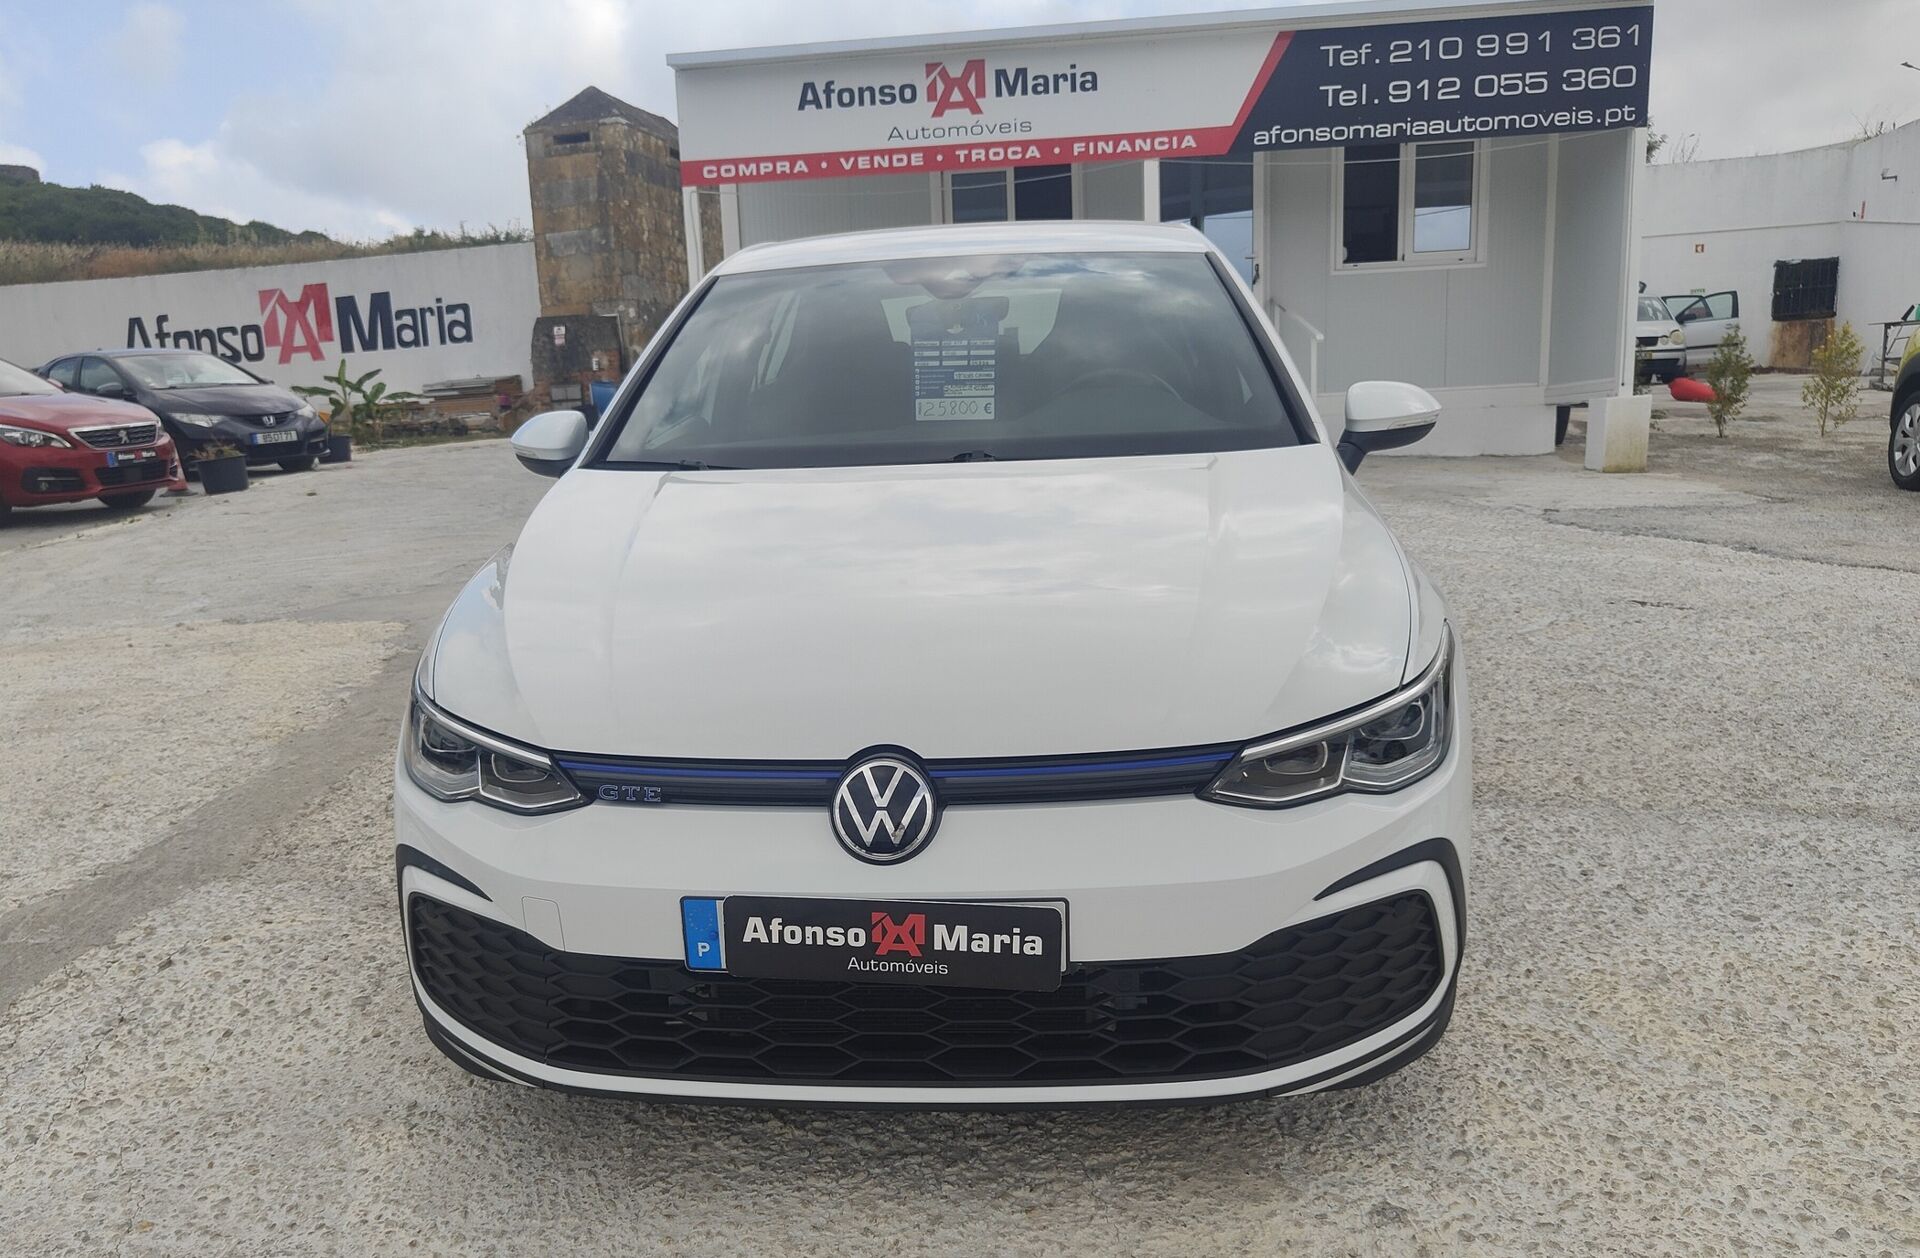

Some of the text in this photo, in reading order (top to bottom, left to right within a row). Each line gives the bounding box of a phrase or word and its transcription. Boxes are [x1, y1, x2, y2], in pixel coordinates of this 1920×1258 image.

[1319, 23, 1641, 68] Tef. 210 991 361
[797, 80, 918, 112] Afonso
[994, 64, 1099, 99] Maria
[1318, 64, 1638, 108] Tel. 912 055 360
[886, 116, 1033, 142] Automóveis
[1252, 103, 1637, 146] afonsomariaautomoveis.pt
[702, 134, 1198, 179] COMPRA VENDE TROCA FINANCIA
[334, 291, 474, 354] Maria
[983, 402, 993, 415] €
[598, 784, 662, 802] GTE
[696, 942, 711, 959] P
[742, 916, 867, 947] Afonso
[933, 923, 1043, 956] Maria
[846, 956, 949, 975] Automóveis
